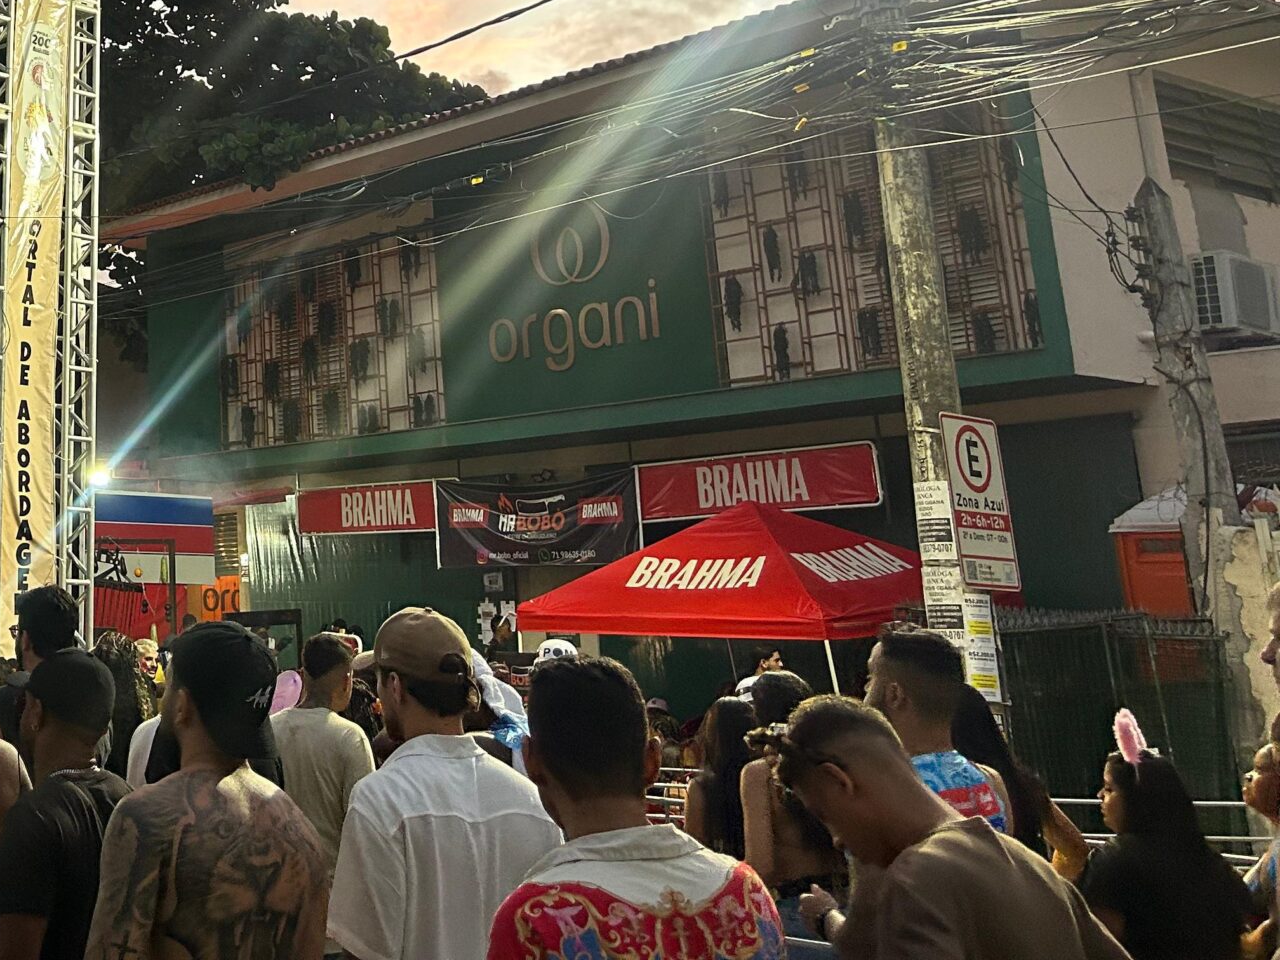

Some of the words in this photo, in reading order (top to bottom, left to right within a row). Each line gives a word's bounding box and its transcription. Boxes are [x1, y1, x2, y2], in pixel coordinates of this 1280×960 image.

[21, 200, 42, 327] ORTAL
[487, 277, 661, 372] organi
[19, 341, 32, 387] DE
[965, 438, 983, 479] E
[695, 456, 810, 509] BRAHMA
[956, 493, 980, 509] Zona
[13, 399, 32, 616] ABORDAGE
[341, 488, 416, 528] BRAHMA
[453, 508, 484, 523] BRAHMA
[581, 501, 618, 519] BRAHMA
[625, 555, 767, 590] BRAHMA
[790, 542, 914, 584] BRAHMA
